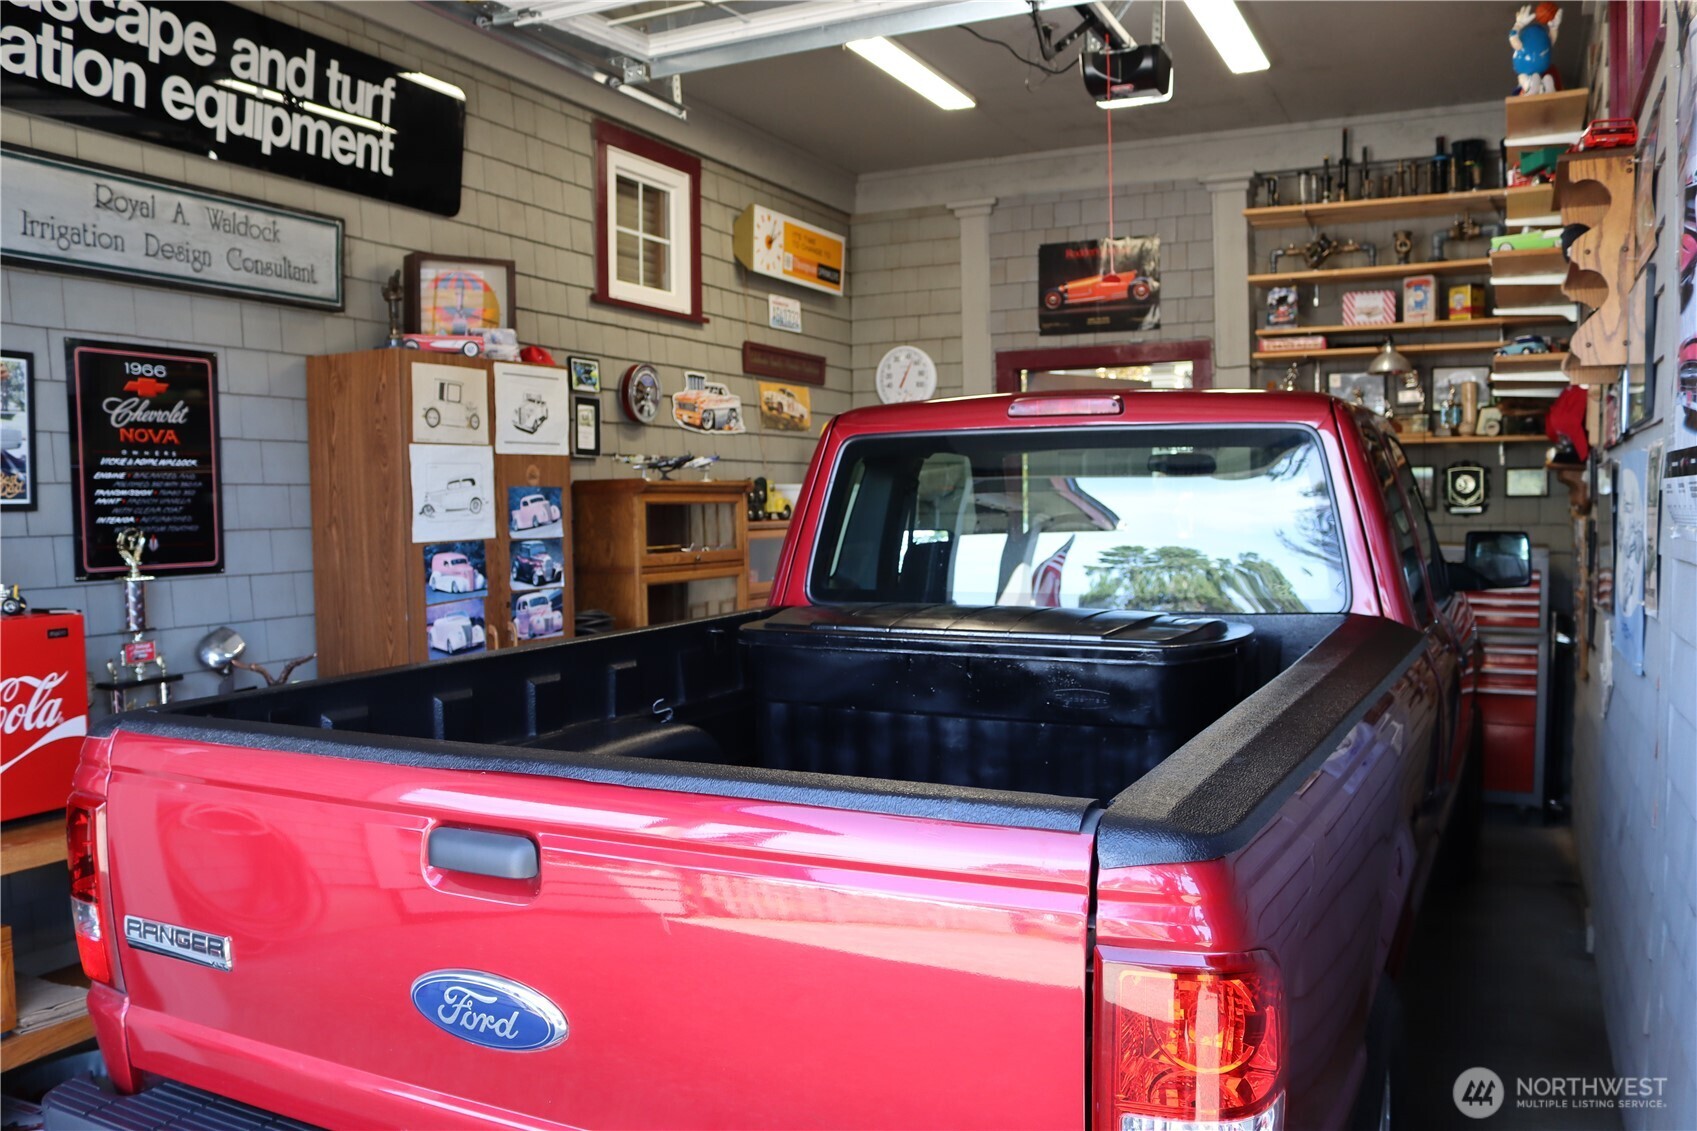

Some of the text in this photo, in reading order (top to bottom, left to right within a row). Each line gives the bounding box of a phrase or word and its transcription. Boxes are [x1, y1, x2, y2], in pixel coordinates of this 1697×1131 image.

[230, 37, 315, 100] and
[326, 59, 396, 123] turf
[161, 75, 394, 177] equipment
[93, 183, 281, 244] Royal A. Waldock
[20, 209, 319, 285] Irrigation Design Consultant
[124, 362, 167, 378] 1966
[102, 396, 189, 428] Chevrolet
[119, 427, 181, 445] NOVA
[126, 918, 225, 958] RANGER
[437, 986, 520, 1040] Ford
